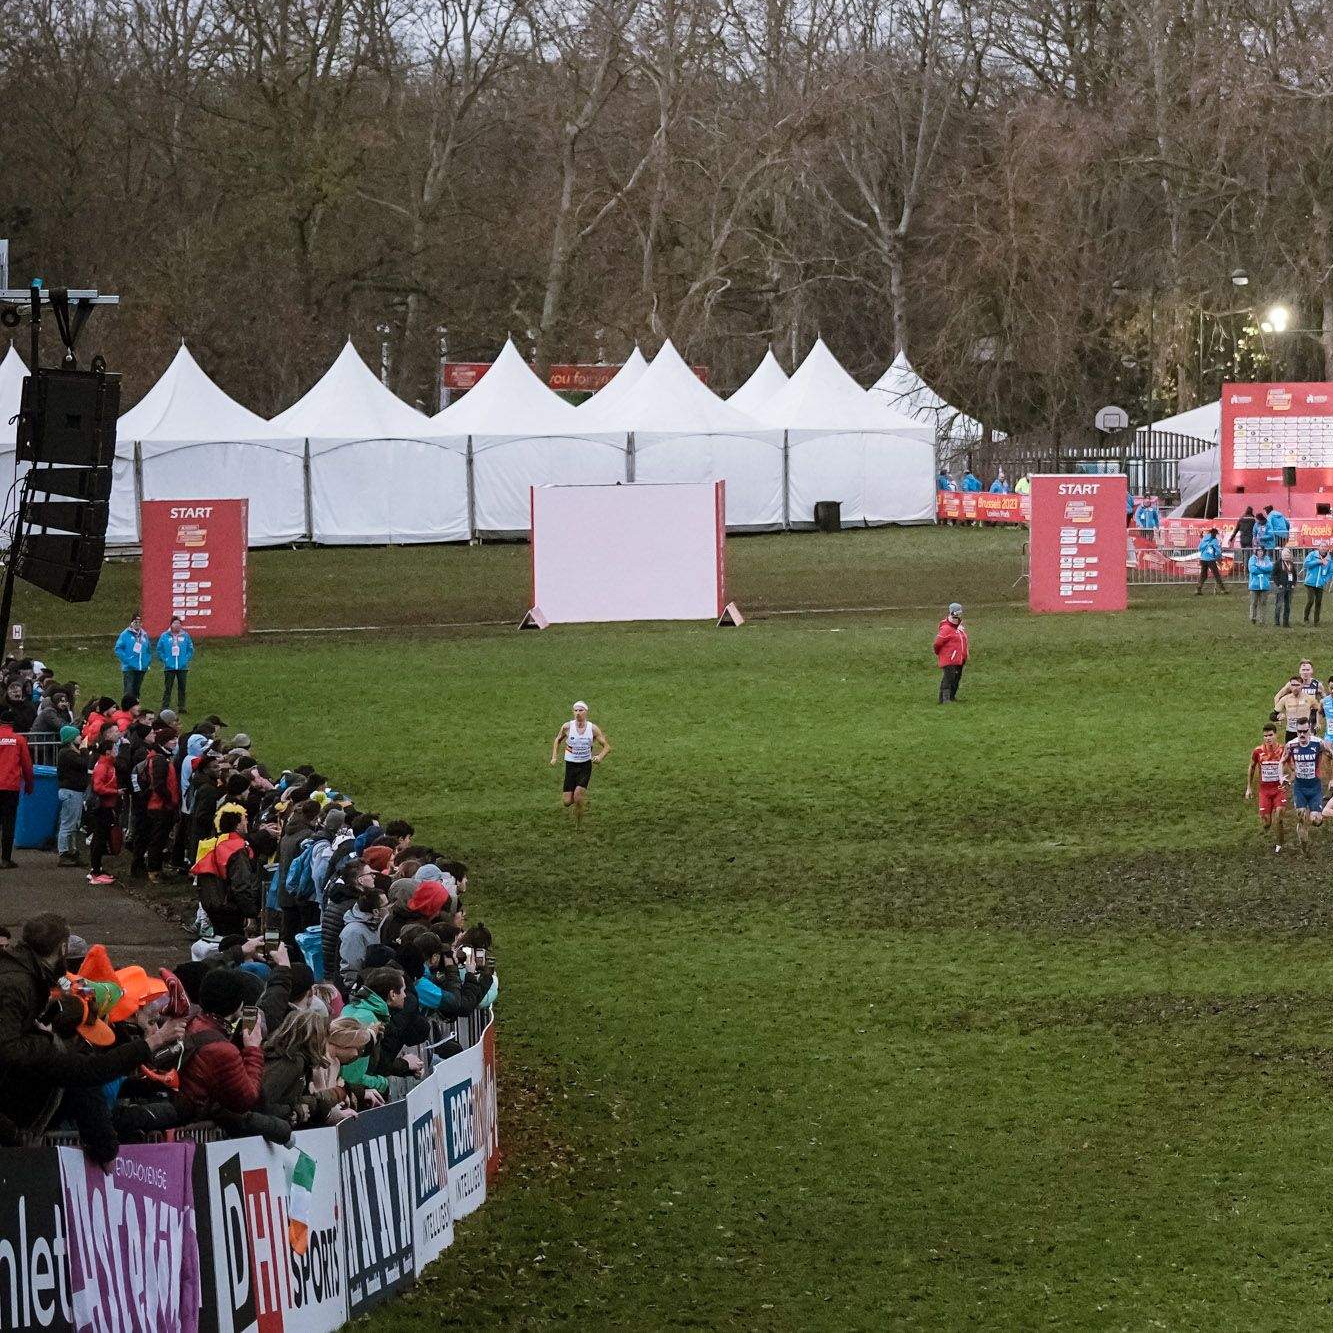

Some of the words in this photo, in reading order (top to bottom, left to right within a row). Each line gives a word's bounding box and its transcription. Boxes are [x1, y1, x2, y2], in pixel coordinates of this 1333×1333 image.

[1058, 483, 1100, 495] START
[170, 507, 213, 519] START
[1300, 523, 1333, 536] Brussels
[1294, 753, 1316, 761] NORWAY
[289, 1226, 340, 1309] SPORTS
